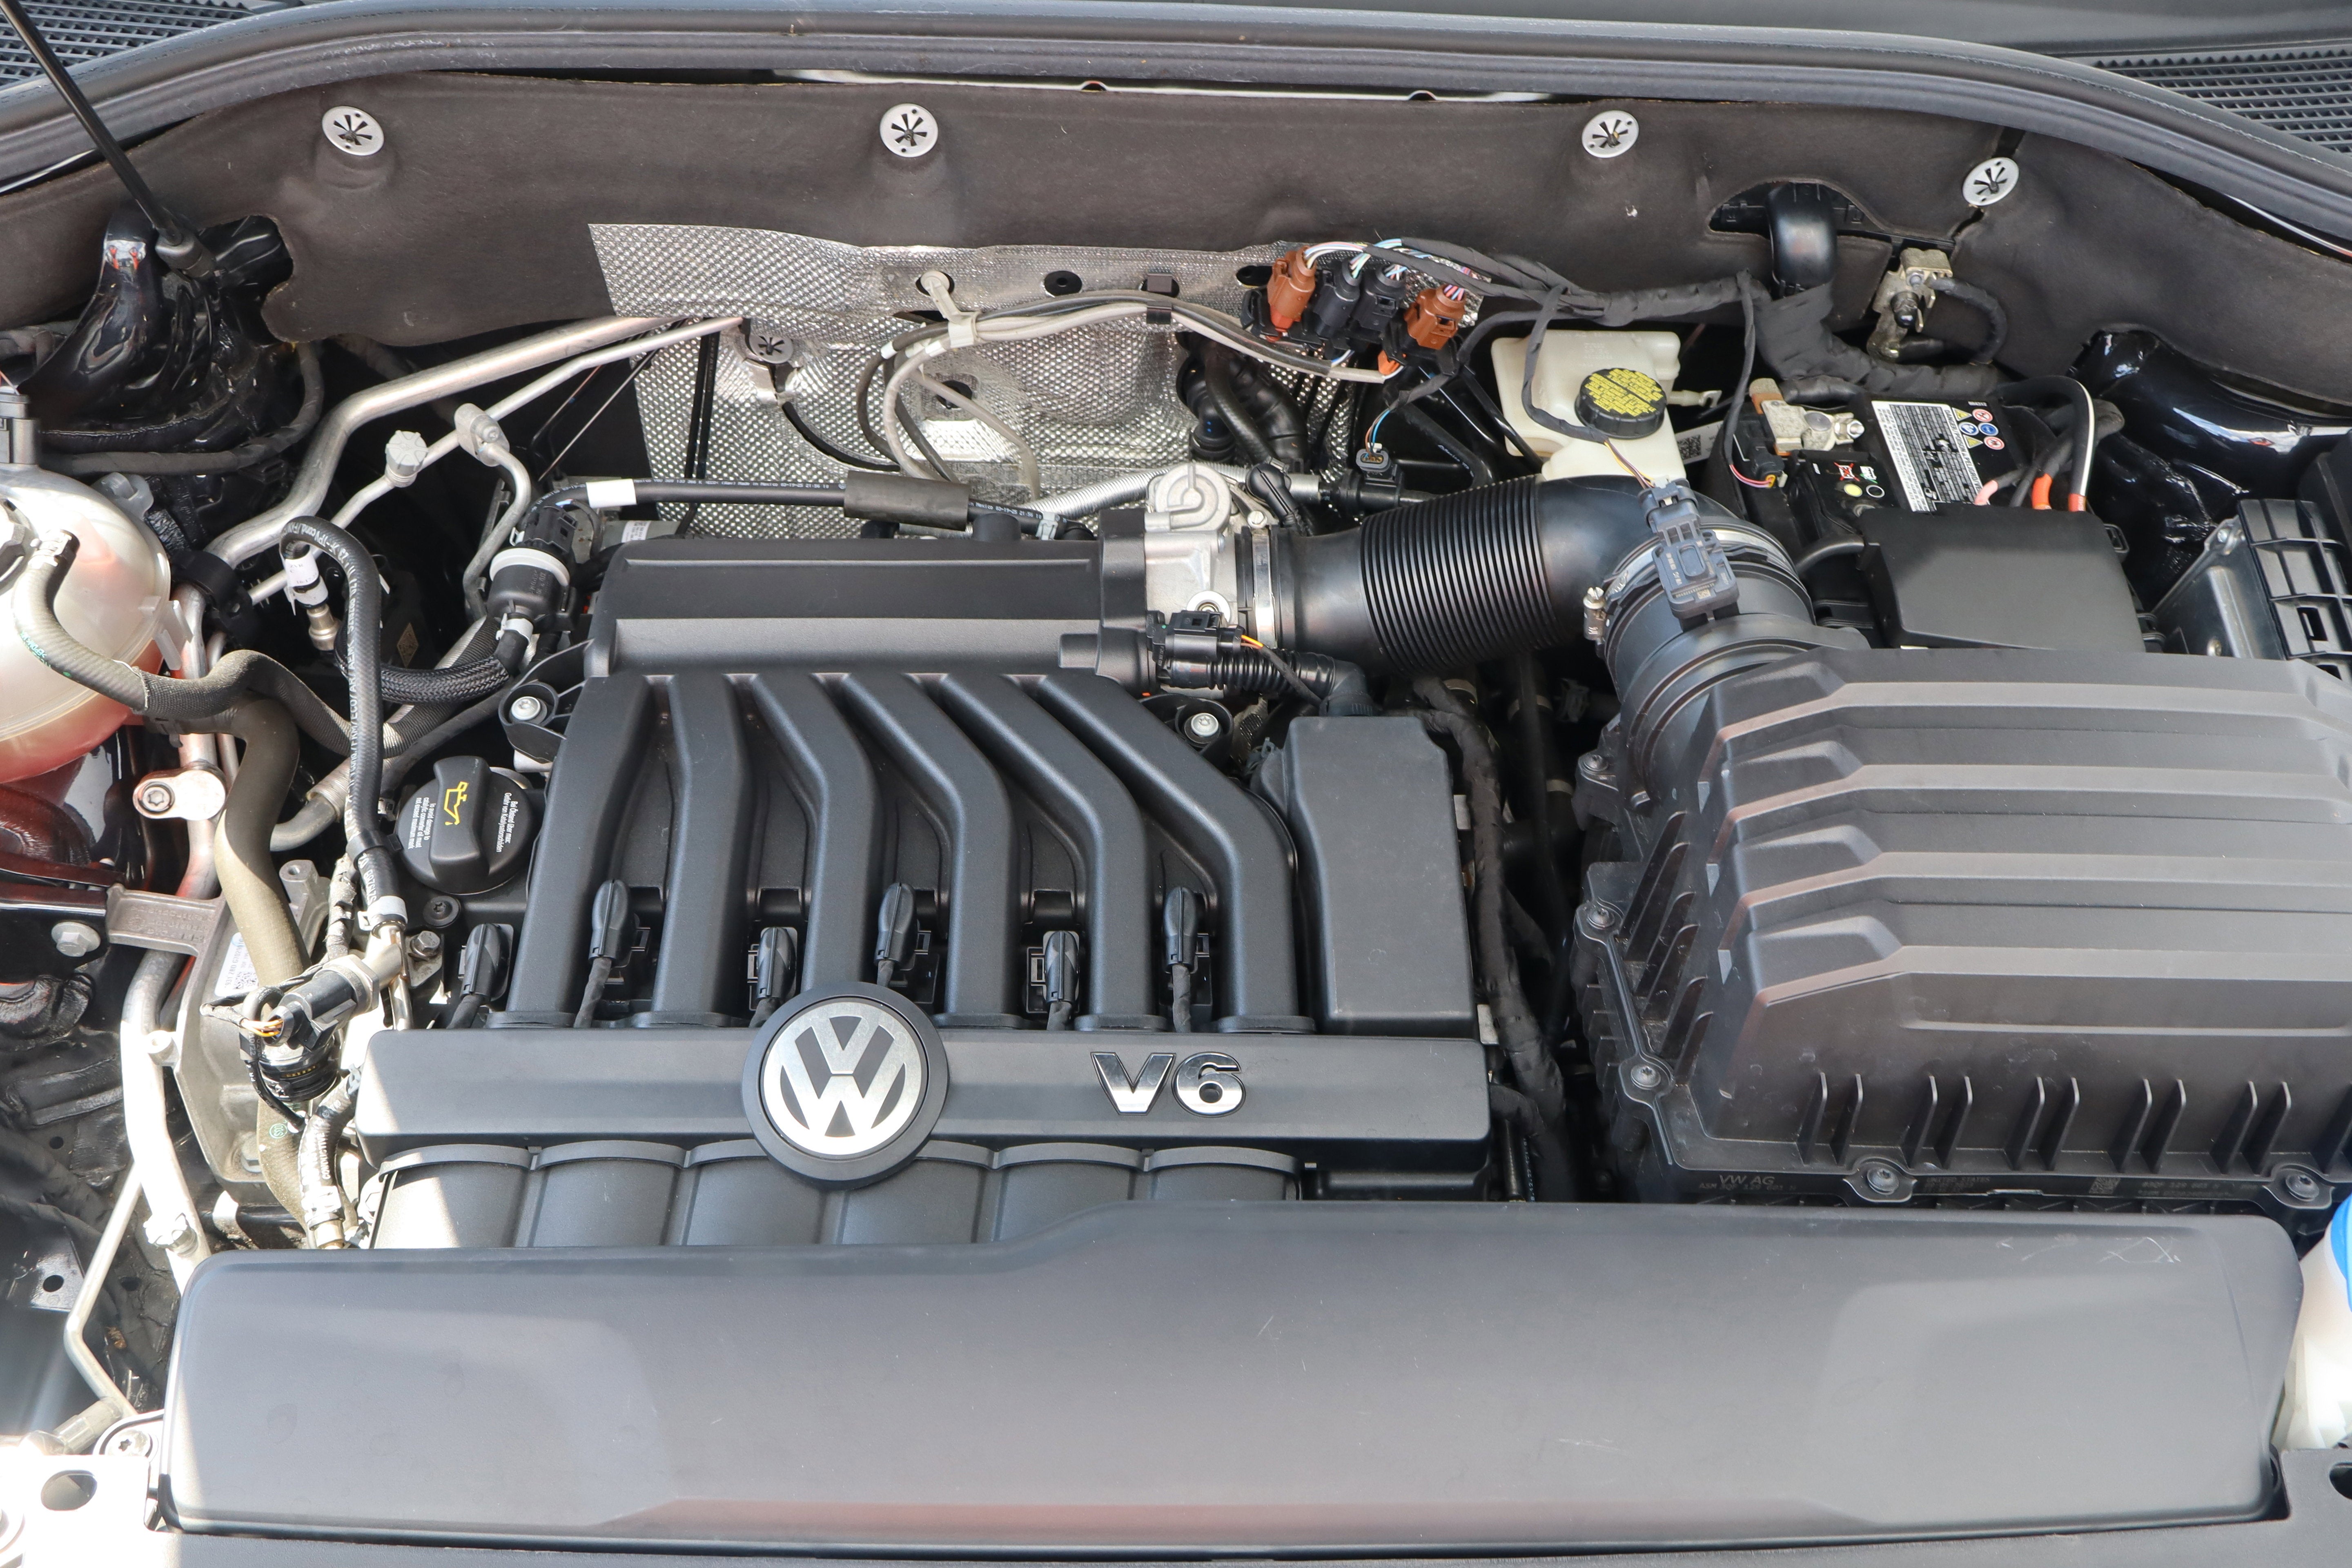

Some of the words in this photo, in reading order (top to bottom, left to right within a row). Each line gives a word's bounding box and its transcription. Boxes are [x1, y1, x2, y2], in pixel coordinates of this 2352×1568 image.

[1964, 457, 1982, 492] PELIGRO/VE
[421, 797, 429, 812] catalytic
[503, 793, 512, 805] Gefahr
[423, 819, 433, 835] damage
[496, 813, 508, 852] Katalysatorschäden
[1091, 1052, 1245, 1117] V6
[316, 1132, 331, 1180] CONDUCTIVE
[1719, 1175, 1747, 1185] VW
[1750, 1176, 1775, 1185] AG
